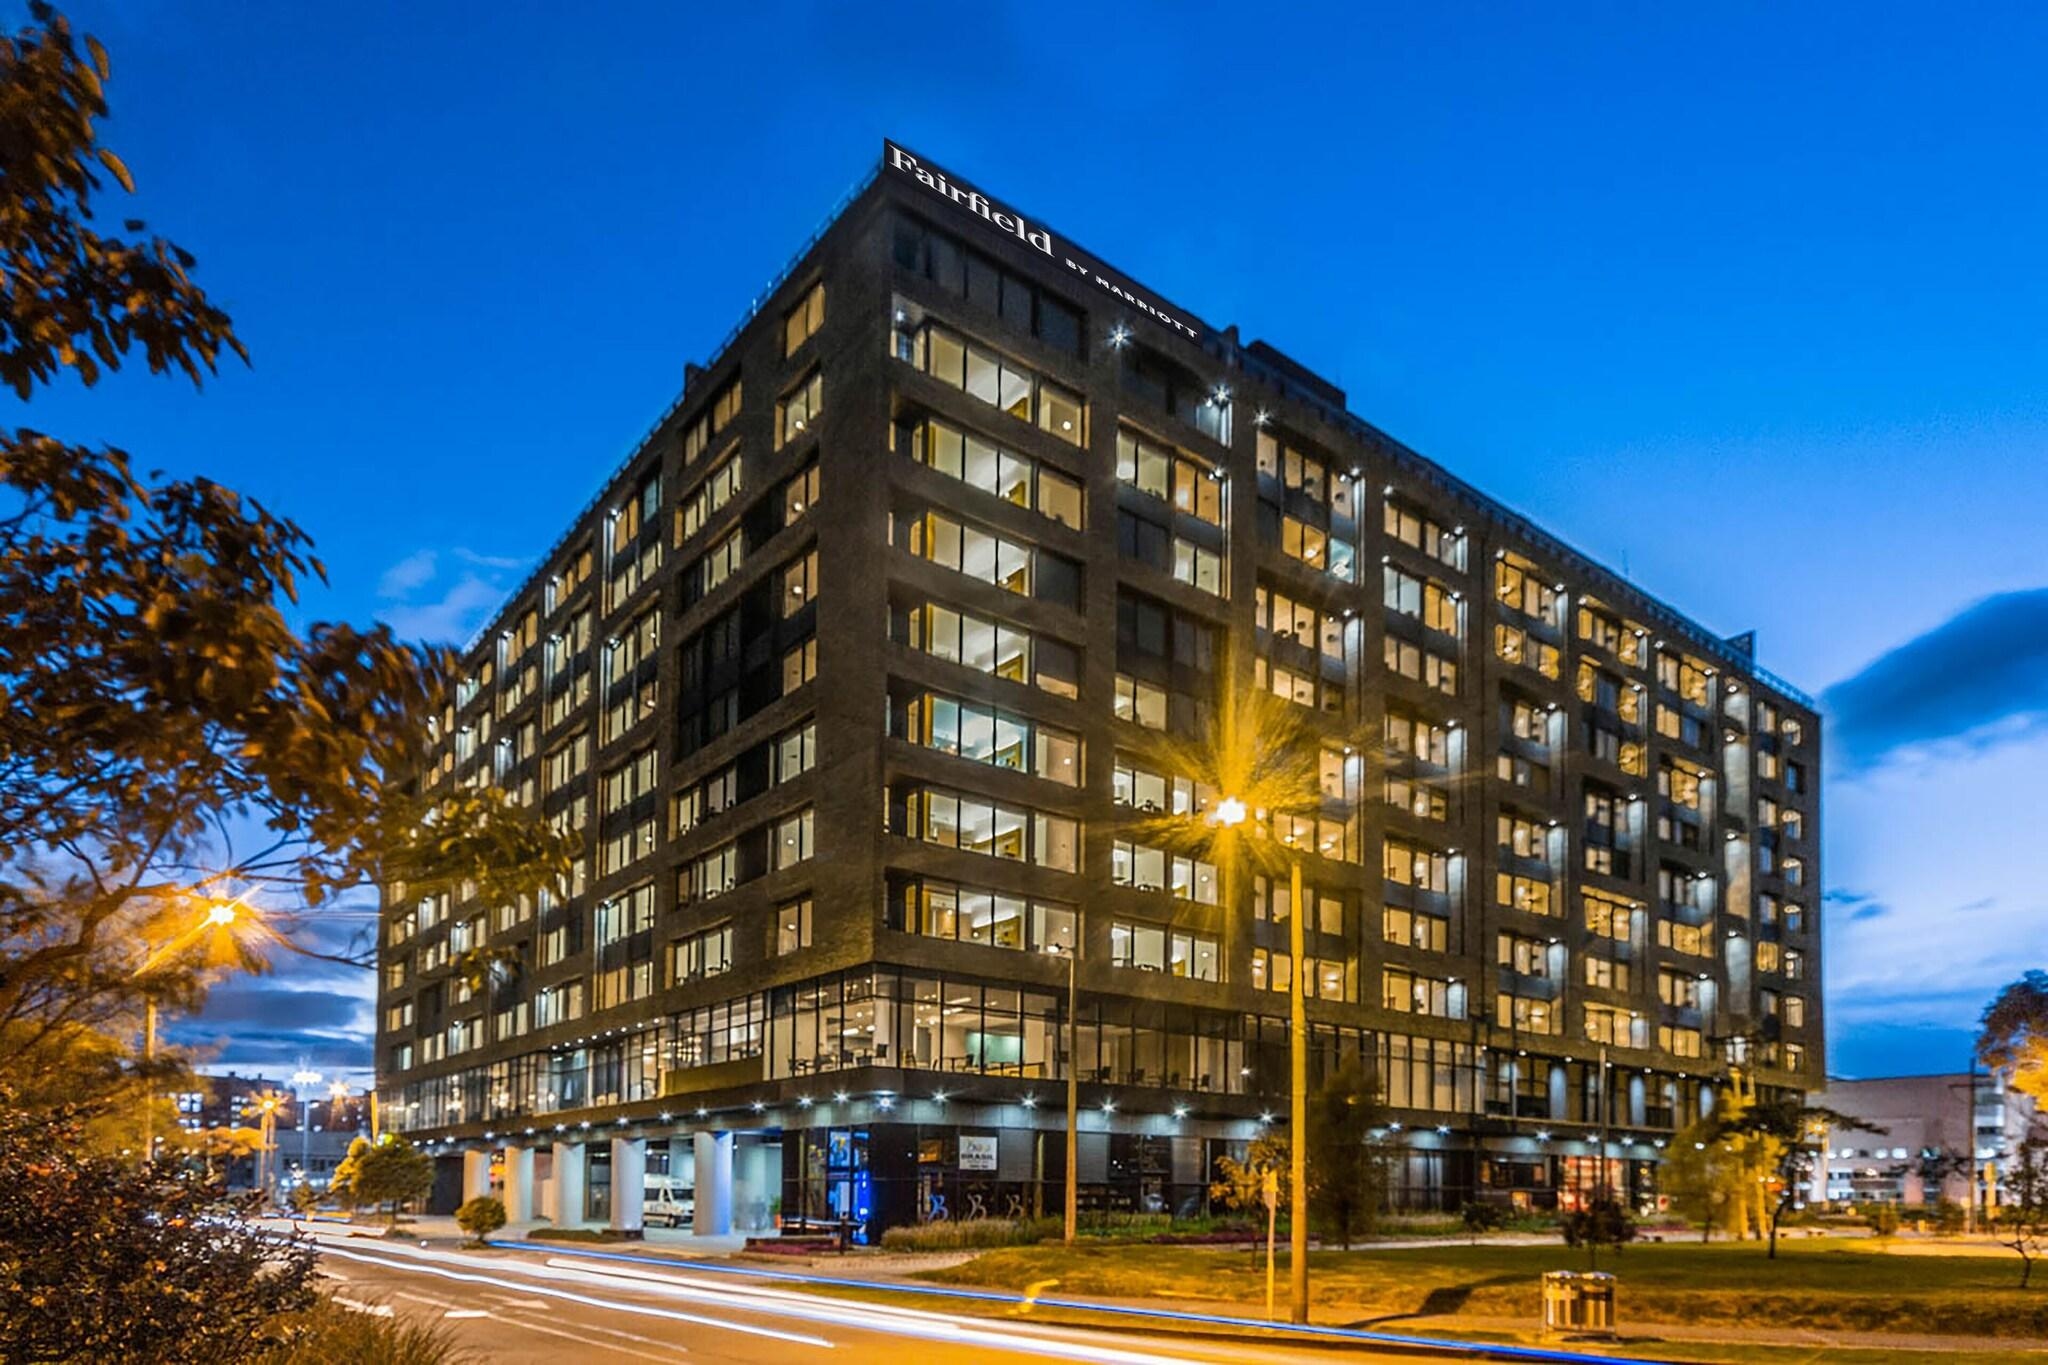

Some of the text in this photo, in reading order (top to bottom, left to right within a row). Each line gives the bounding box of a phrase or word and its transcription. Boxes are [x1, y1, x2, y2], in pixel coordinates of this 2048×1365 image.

[888, 143, 1198, 338] Fairfield BY MARRIOTT
